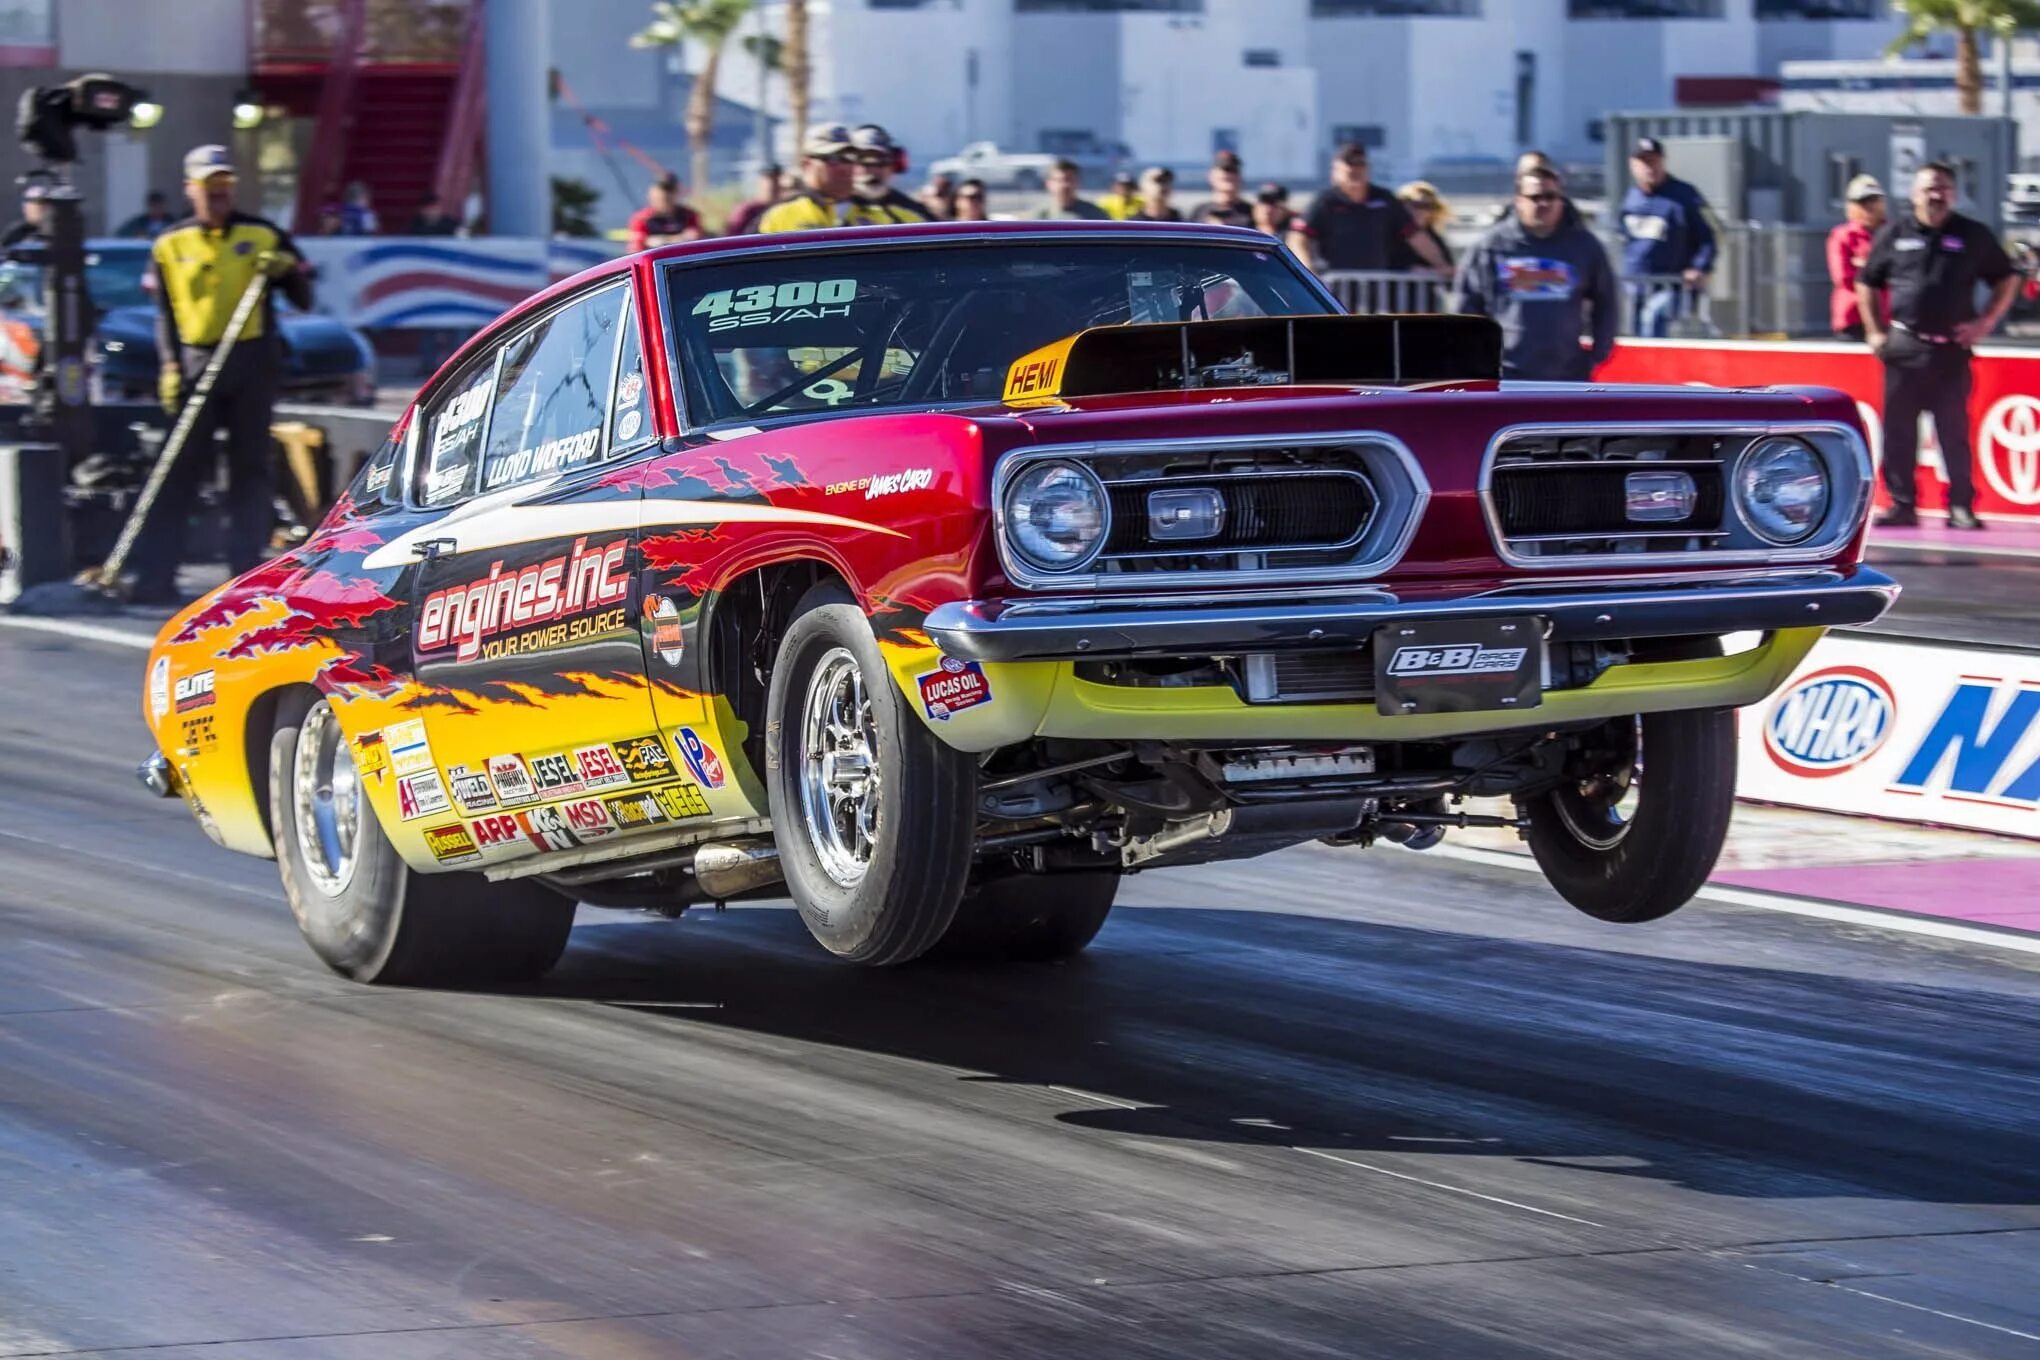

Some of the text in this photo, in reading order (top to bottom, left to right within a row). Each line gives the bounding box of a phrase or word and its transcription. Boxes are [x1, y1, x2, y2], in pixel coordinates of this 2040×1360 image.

[691, 279, 857, 318] 4300
[708, 304, 850, 333] SS/AH
[1008, 358, 1060, 396] HEMI
[487, 448, 532, 489] LLOYD
[530, 428, 601, 475] WOFFORD
[825, 467, 933, 501] ENGINE BY JAMES CARO
[481, 636, 517, 661] YOUR
[520, 623, 567, 652] POWER
[569, 607, 626, 639] SOURCE
[1394, 648, 1475, 670] B&B
[175, 670, 215, 701] ELITE
[926, 673, 981, 702] LUCAS OIL
[1776, 682, 1883, 760] NHRA
[494, 769, 528, 790] PHOENIX
[531, 755, 580, 790] JESEL
[577, 748, 623, 780] JESEL
[472, 814, 517, 846] ARP
[565, 800, 608, 830] MSD
